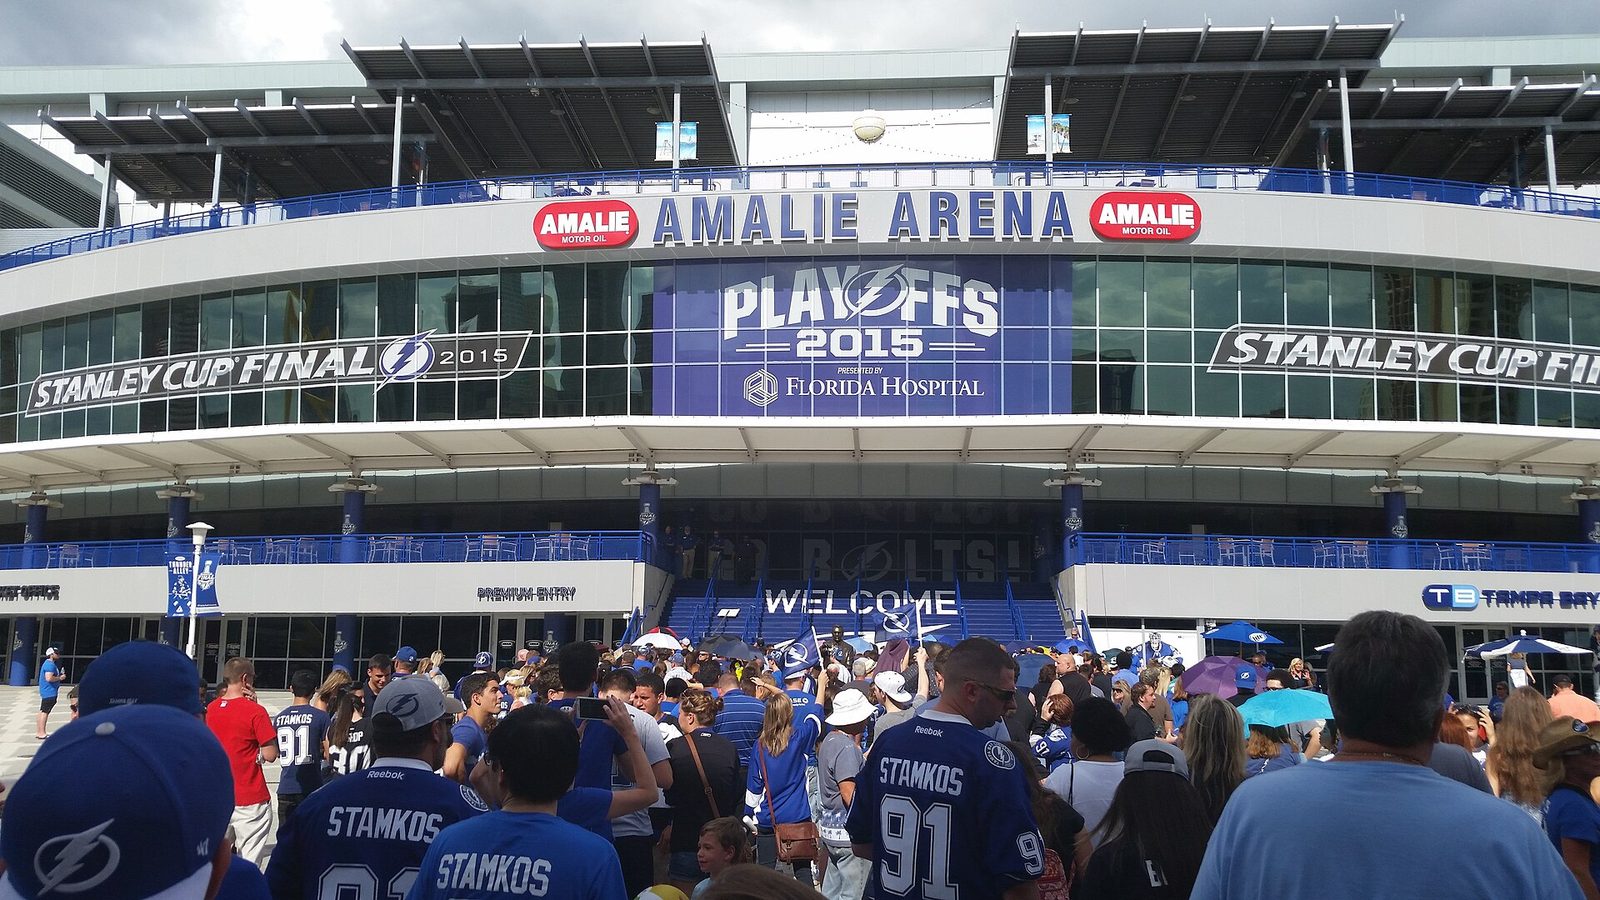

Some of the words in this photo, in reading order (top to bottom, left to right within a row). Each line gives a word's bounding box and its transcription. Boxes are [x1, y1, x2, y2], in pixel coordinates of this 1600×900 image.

[540, 210, 630, 235] AMALIE
[652, 192, 859, 243] AMALIE
[887, 190, 1075, 239] ARENA
[1098, 203, 1195, 226] AMALIE
[1122, 227, 1154, 235] MOTOR
[796, 328, 924, 358] 2015
[1227, 332, 1448, 372] STANLEY
[34, 364, 163, 408] STANLEY
[238, 345, 376, 384] FINAL
[439, 348, 508, 365] 2015
[837, 367, 873, 375] PRESENTED
[785, 377, 876, 396] FLORIDA
[881, 376, 985, 396] HOSPITAL
[477, 587, 533, 600] PREMIUM
[536, 586, 577, 600] ENTRY
[765, 589, 959, 615] WELCOME
[1481, 589, 1554, 607] TAMPA
[1558, 591, 1600, 608] BAY
[276, 714, 313, 726] STAMKOS
[915, 725, 944, 738] Reebok
[277, 725, 313, 767] 91
[367, 770, 404, 780] Reebok
[880, 757, 964, 796] STAMKOS
[327, 806, 443, 844] STAMKOS
[880, 793, 960, 900] 91
[436, 852, 552, 897] STAMKOS
